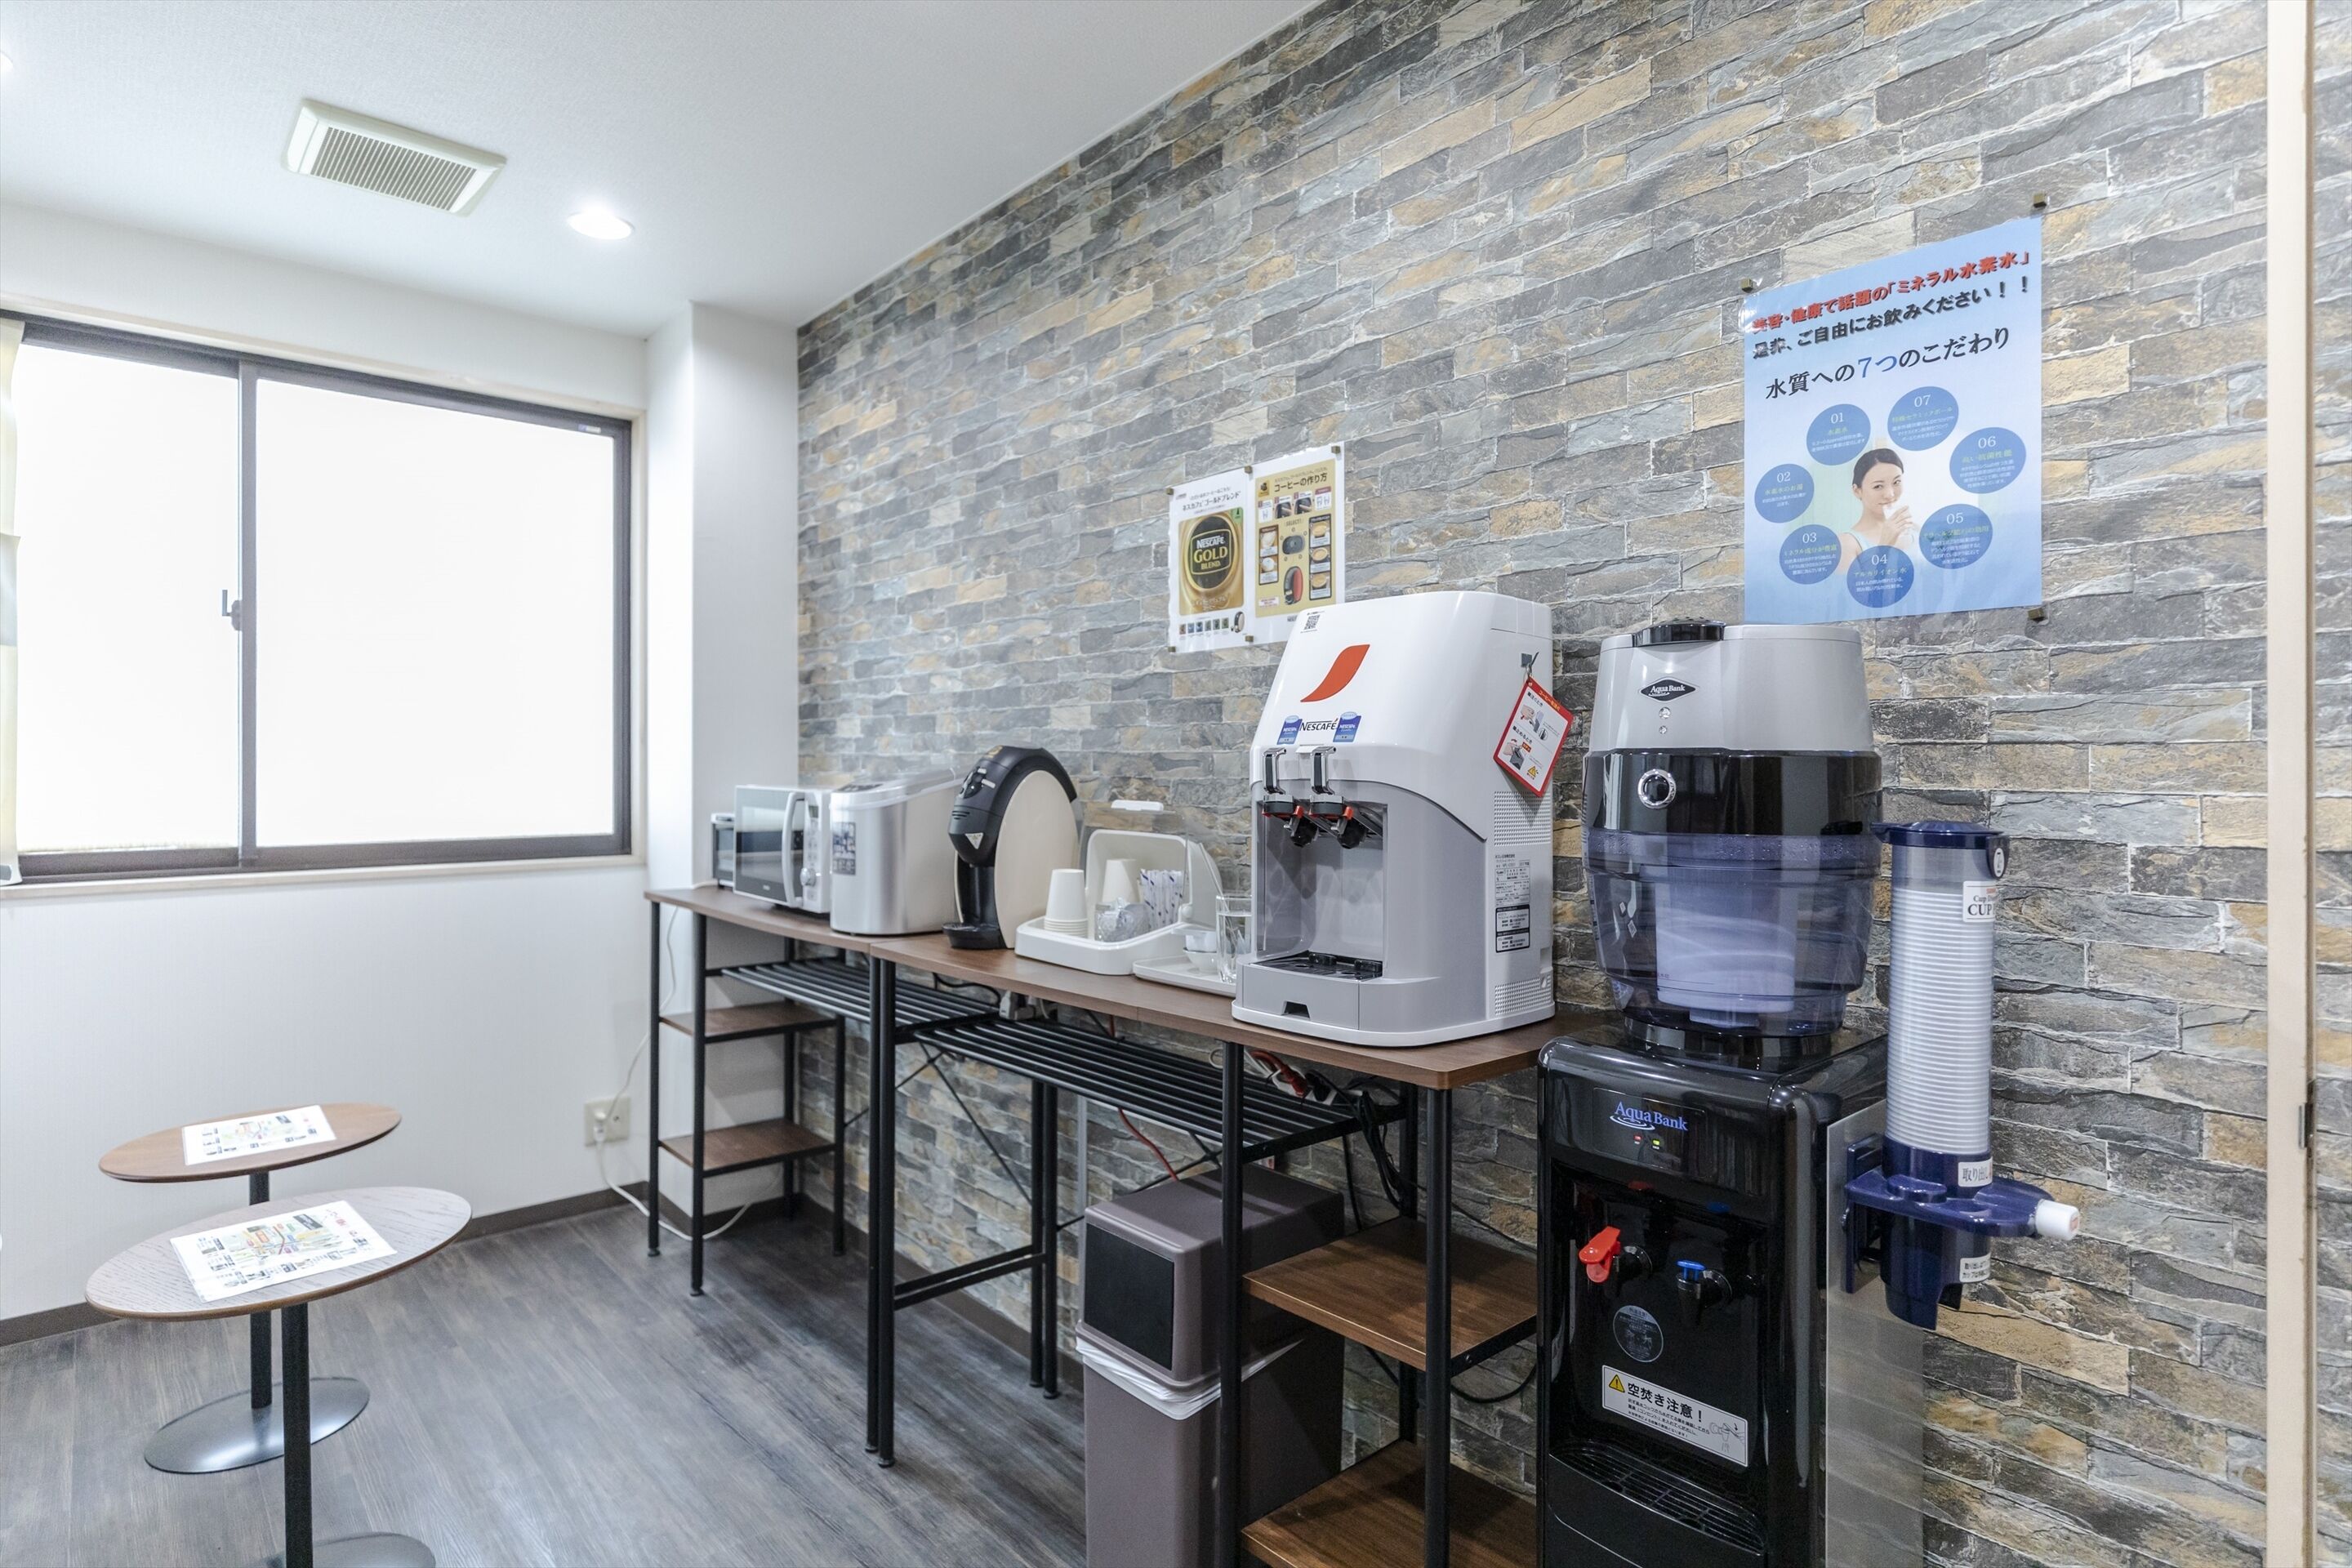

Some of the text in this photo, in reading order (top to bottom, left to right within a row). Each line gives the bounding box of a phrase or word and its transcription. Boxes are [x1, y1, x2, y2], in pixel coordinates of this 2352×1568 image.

[1766, 327, 2010, 399] 水質への7つのこだわり
[1914, 394, 1931, 407] 07
[1830, 412, 1843, 424] 01
[1978, 435, 1996, 448] 06
[1274, 473, 1327, 492] コーヒーの作り方
[1777, 471, 1790, 483] 02
[1946, 512, 1963, 524] 05
[1802, 532, 1817, 543] 03
[1194, 546, 1228, 563] GOLD
[1871, 554, 1887, 565] 04
[1200, 560, 1221, 570] BLEND
[1973, 894, 1986, 903] Cup
[1967, 903, 1993, 915] CUP
